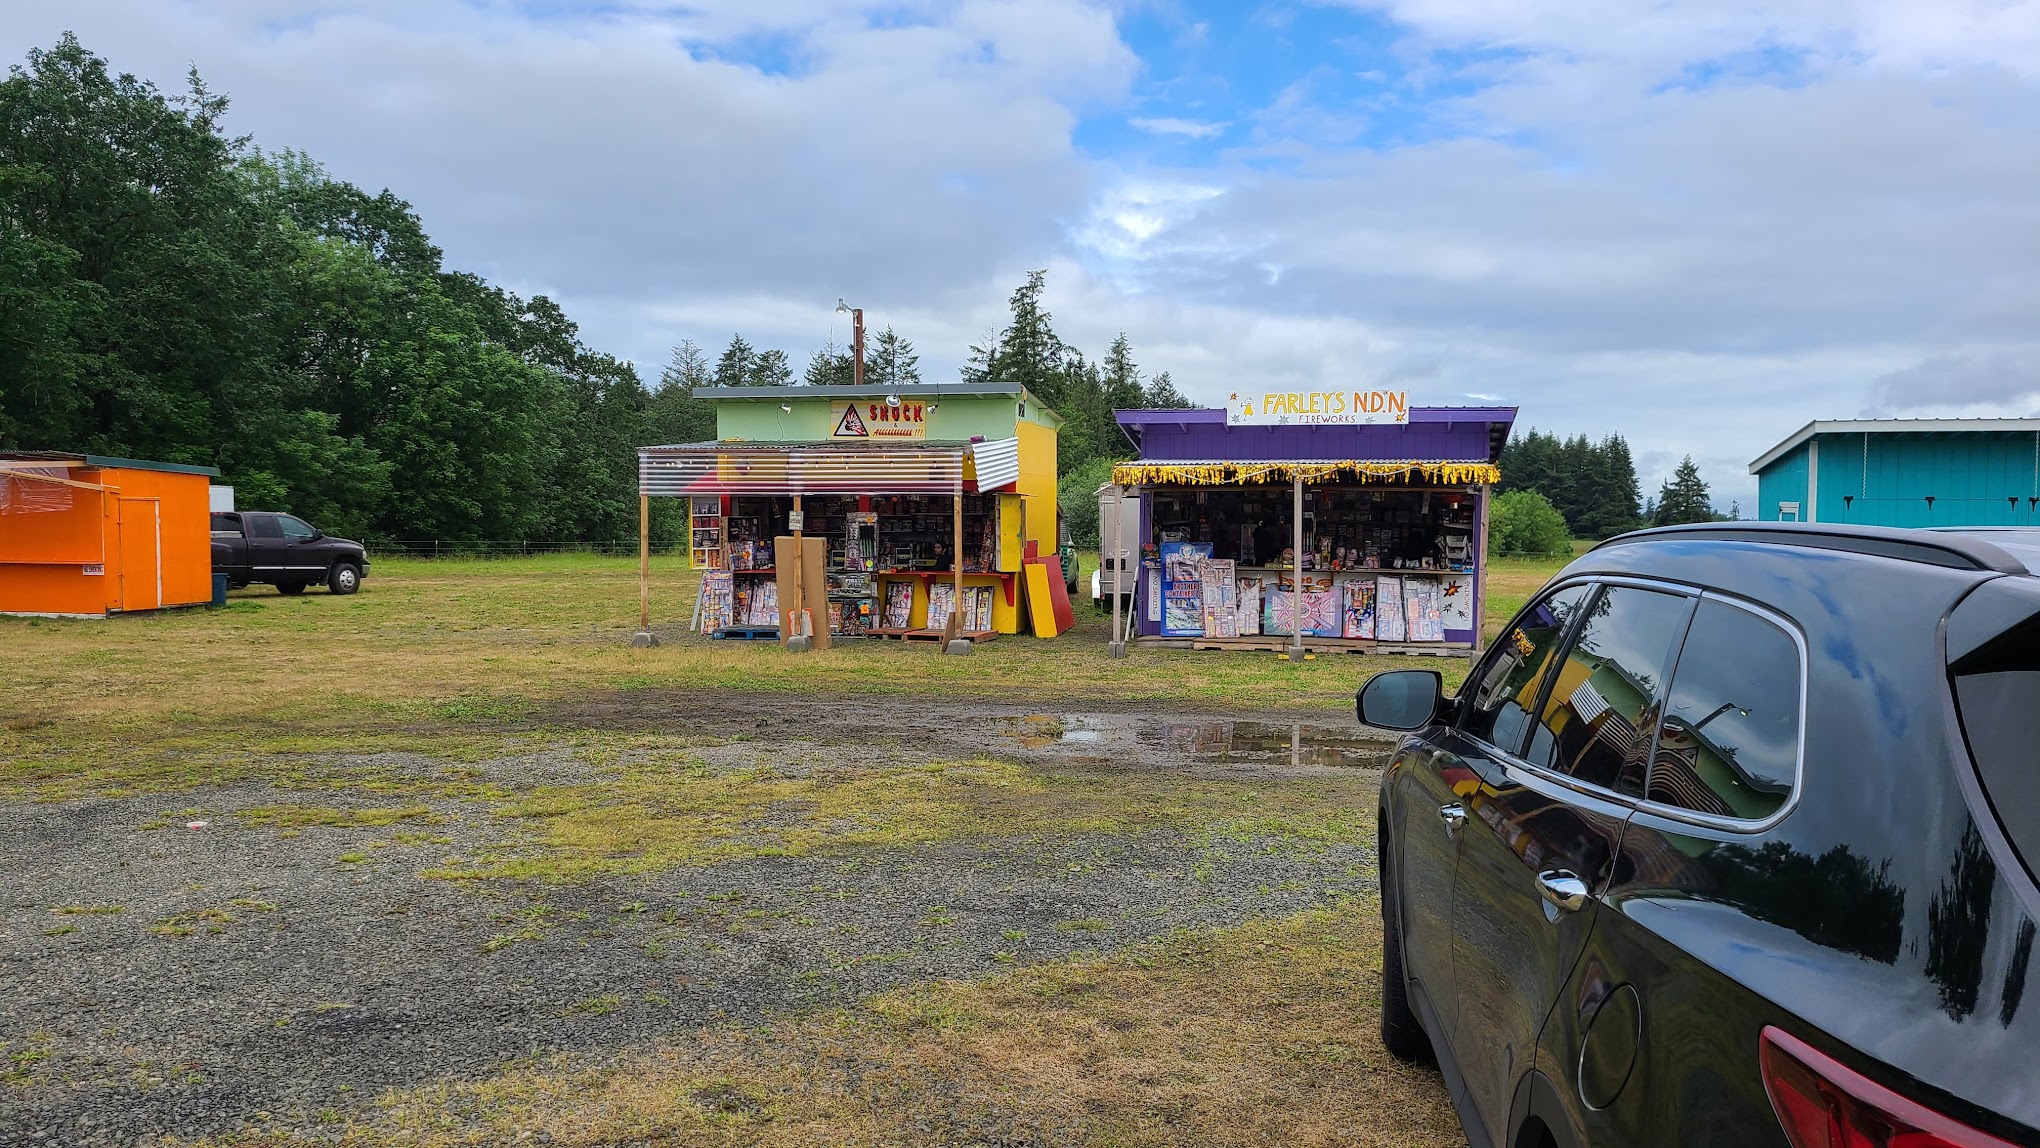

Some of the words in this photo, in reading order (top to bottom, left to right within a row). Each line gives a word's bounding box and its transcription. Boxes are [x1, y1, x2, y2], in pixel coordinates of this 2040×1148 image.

[1263, 391, 1346, 415] FARLEY'S
[1353, 391, 1407, 414] N.D.N.
[869, 404, 923, 422] SHOCK
[1299, 415, 1356, 424] FIREWORKS
[1152, 575, 1158, 586] NO
